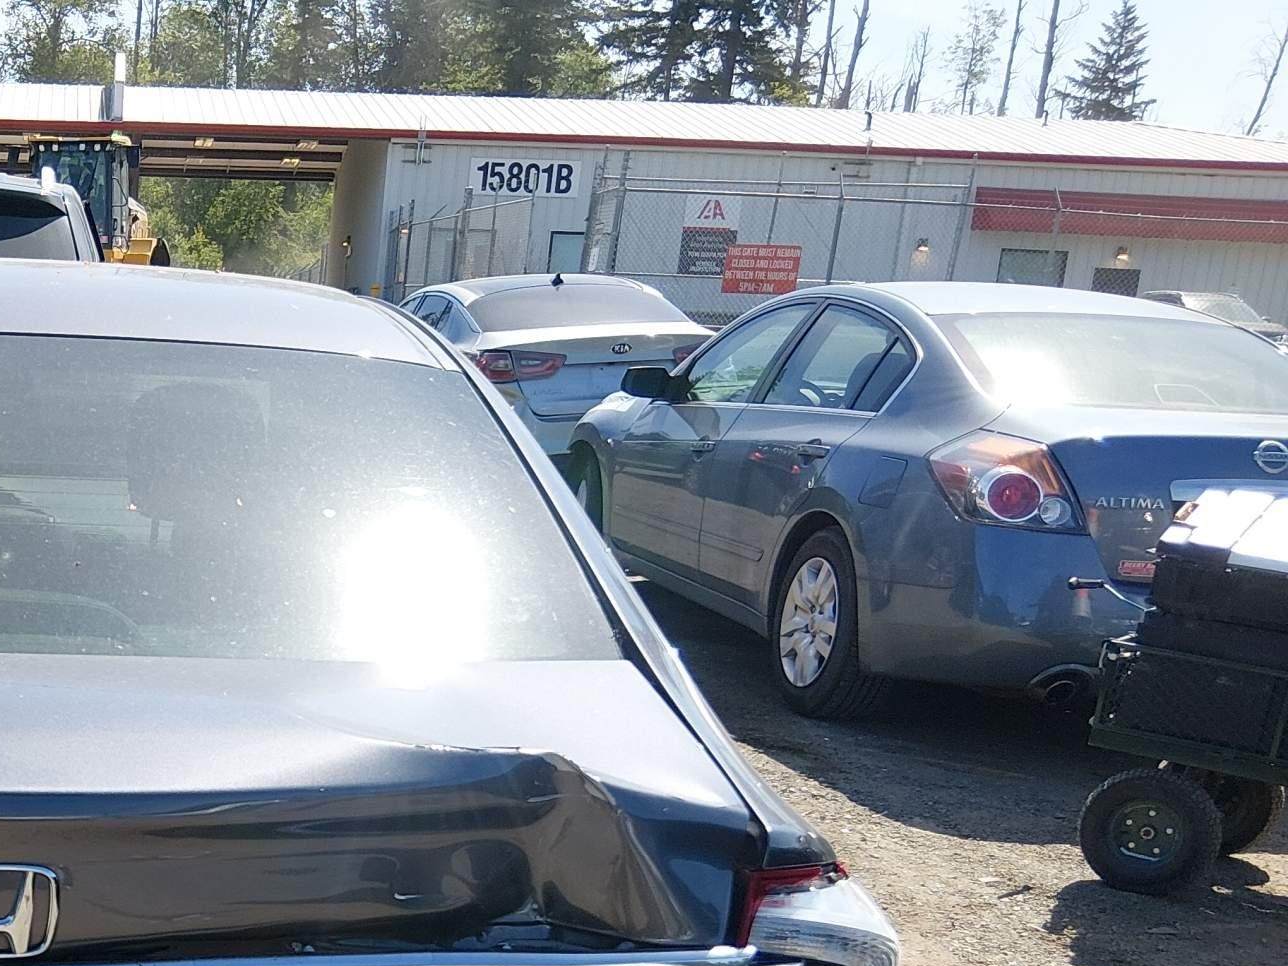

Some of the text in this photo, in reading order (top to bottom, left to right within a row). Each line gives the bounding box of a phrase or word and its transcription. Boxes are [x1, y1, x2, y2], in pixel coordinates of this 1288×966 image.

[476, 161, 574, 194] 15801B
[728, 247, 742, 256] THIS
[742, 247, 759, 257] GATE
[759, 248, 776, 257] MUST
[776, 248, 802, 258] REMAIN
[731, 258, 794, 270] CLOSED AND LOCKED
[724, 270, 754, 280] BETWEEN
[754, 271, 768, 281] THE
[768, 271, 789, 281] HOURS
[614, 344, 630, 353] KIA
[1096, 495, 1165, 510] ALTIMA
